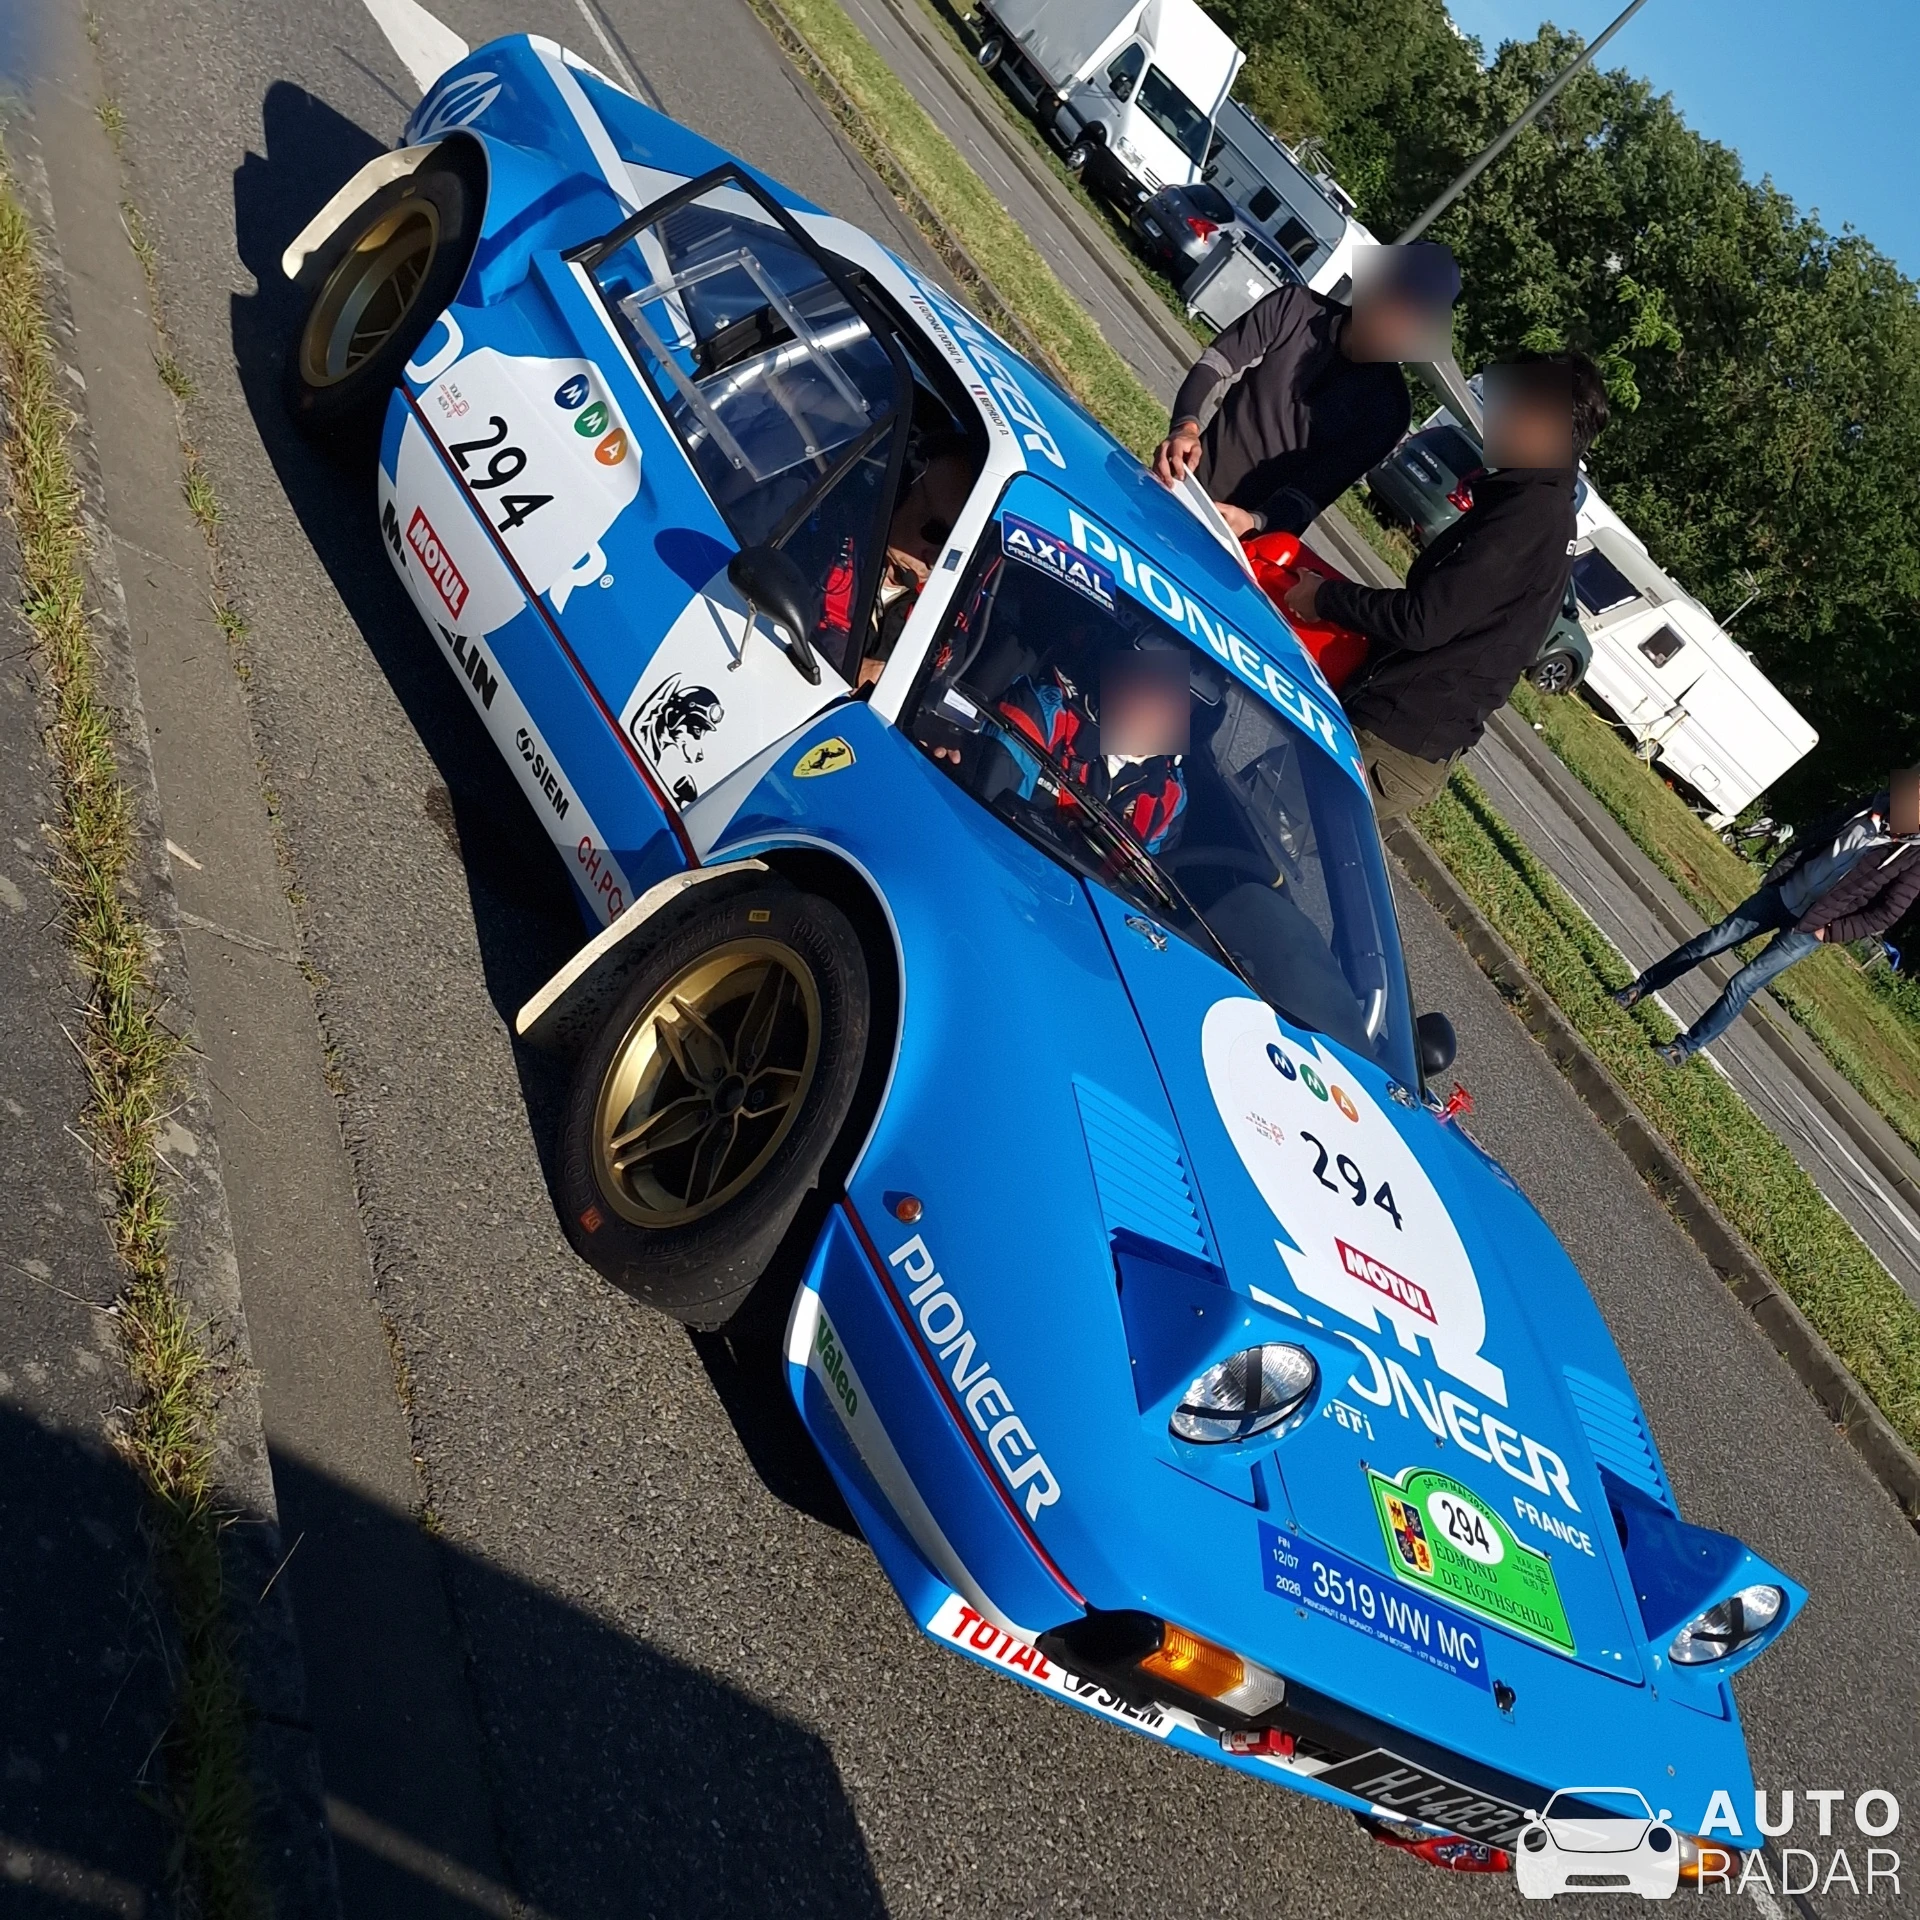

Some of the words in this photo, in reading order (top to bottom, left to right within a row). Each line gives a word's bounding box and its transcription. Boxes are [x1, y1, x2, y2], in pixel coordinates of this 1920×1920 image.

[448, 416, 555, 533] 294
[410, 521, 467, 611] MOTUL
[1007, 528, 1113, 602] AXIAL
[1068, 508, 1340, 753] PIONEER
[531, 753, 569, 821] SIEM
[1300, 1130, 1403, 1231] 294
[1344, 1246, 1432, 1319] MOTUL
[815, 1314, 858, 1417] Valeo
[888, 1234, 1061, 1522] PIONEER
[1272, 1548, 1300, 1570] 12/07
[1432, 1539, 1498, 1584] EDMOND
[1441, 1499, 1490, 1554] 294
[1513, 1496, 1596, 1557] FRANCE
[1312, 1561, 1376, 1620] 3519
[1380, 1591, 1430, 1646] WW
[1436, 1619, 1480, 1669] MC
[1441, 1568, 1463, 1591] DE
[1465, 1576, 1555, 1633] ROTHSCHILD
[952, 1606, 1051, 1680] TOTAL
